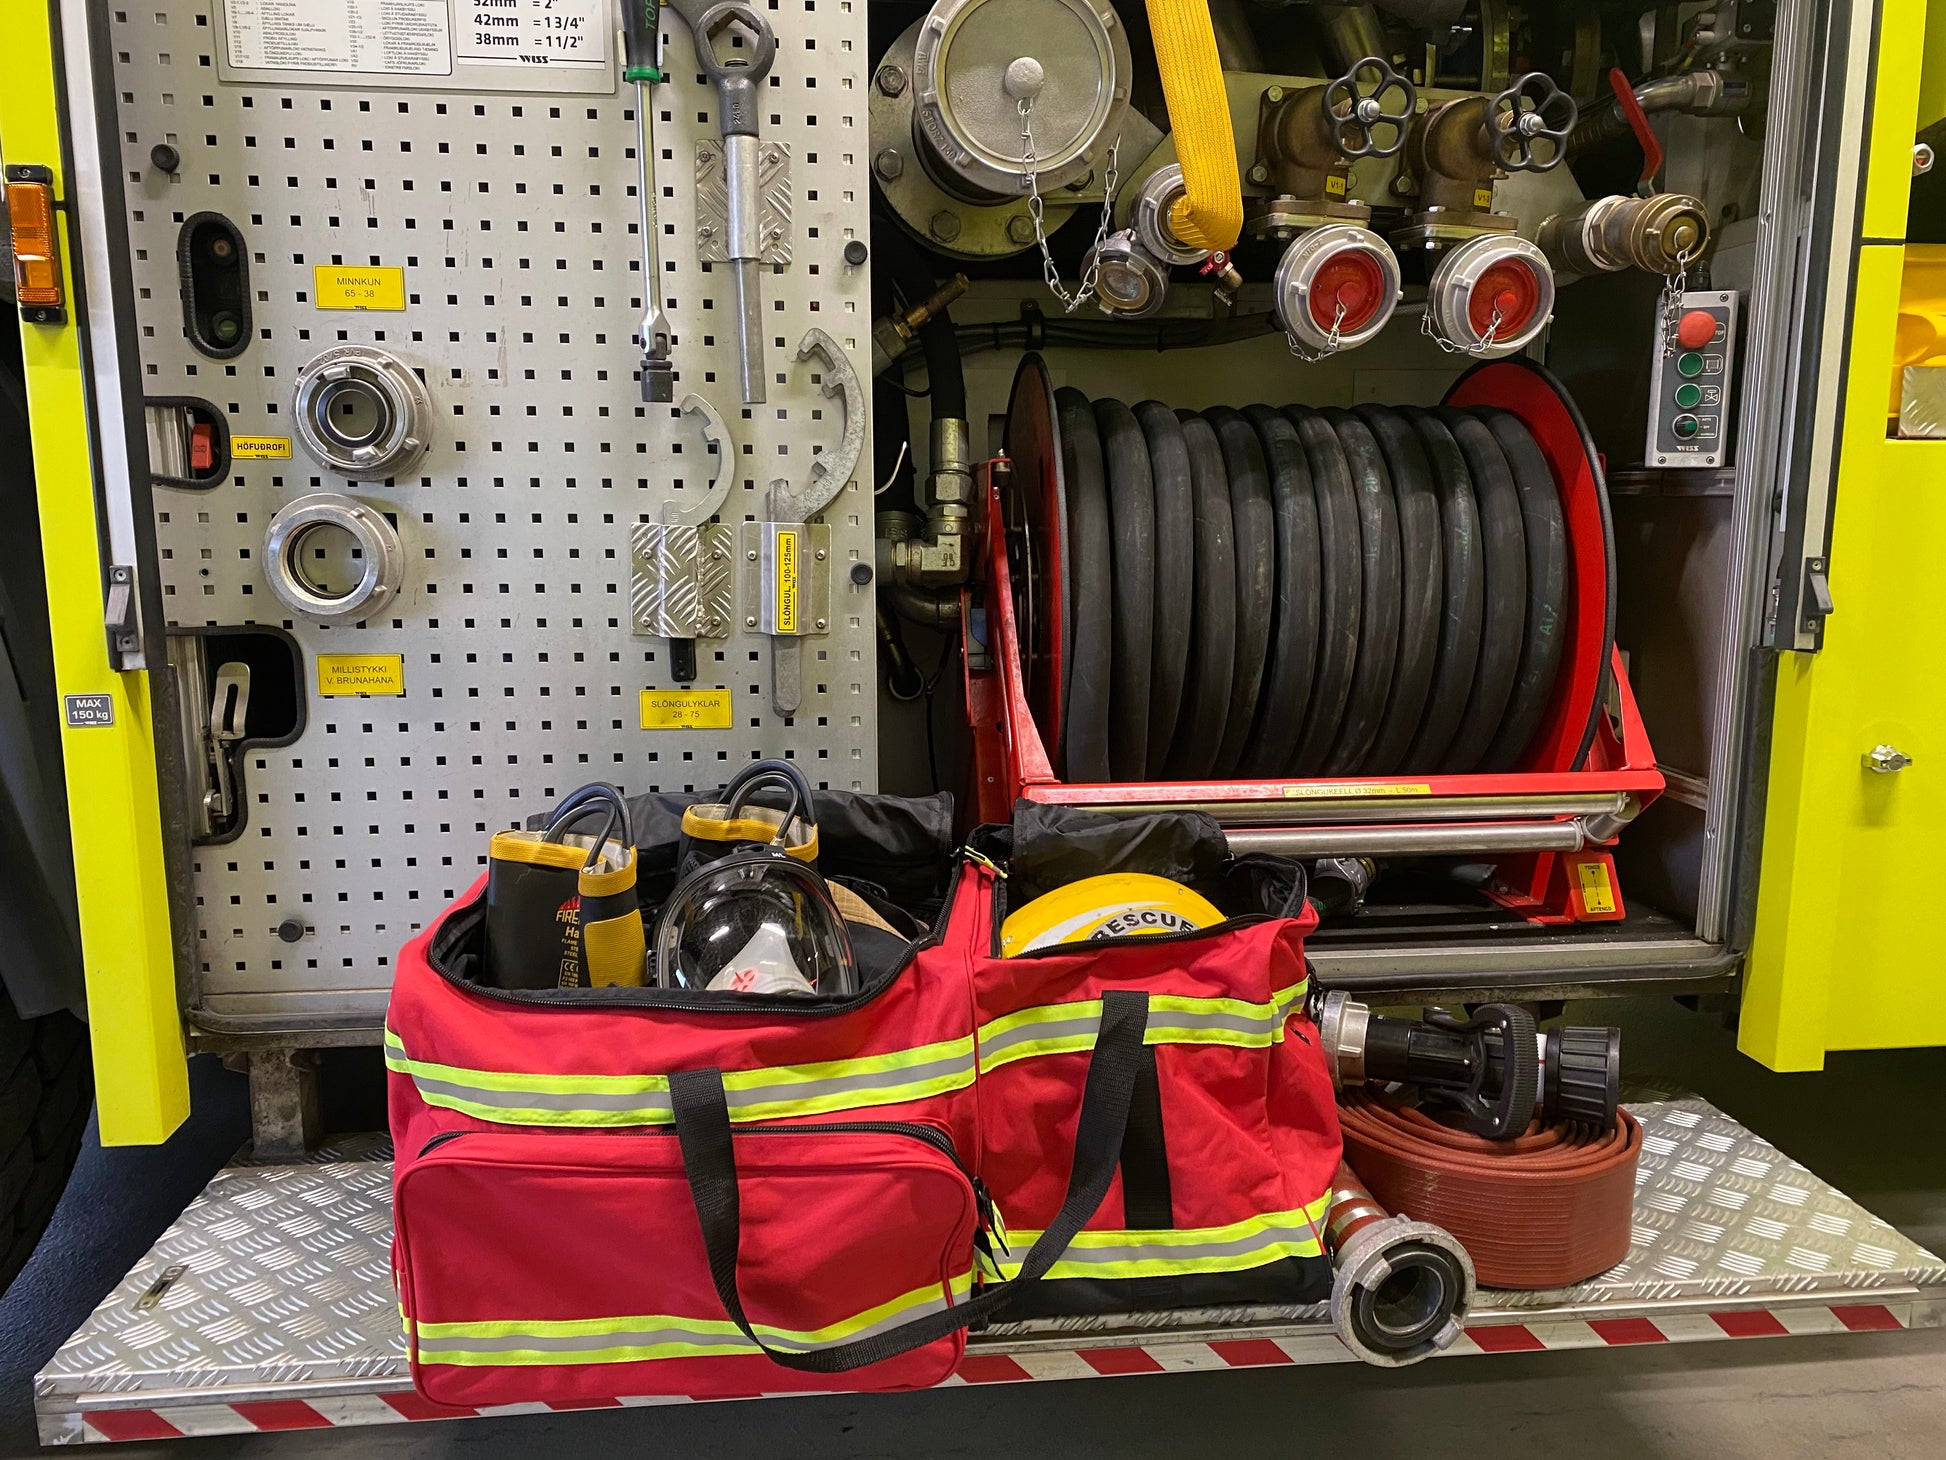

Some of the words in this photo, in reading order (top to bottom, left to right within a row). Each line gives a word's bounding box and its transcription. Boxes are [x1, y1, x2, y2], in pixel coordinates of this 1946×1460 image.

[474, 14, 519, 27] 42mm
[475, 33, 519, 46] 38mm
[518, 55, 548, 63] WISS
[336, 277, 381, 286] MINNKUN
[345, 289, 356, 297] 65
[364, 289, 374, 297] 38
[237, 442, 285, 451] HÖFUÐROFI
[783, 538, 792, 583] 100-125mm
[331, 665, 387, 674] MILLISTYKKI
[336, 676, 394, 684] BRUNAHANA
[76, 699, 102, 708] MAX
[651, 699, 720, 708] SLÖNGULYKLAR
[72, 710, 94, 719] 150
[96, 710, 109, 720] kg
[690, 710, 700, 718] 75
[556, 909, 580, 925] FIRE
[1091, 911, 1194, 940] RESCUE
